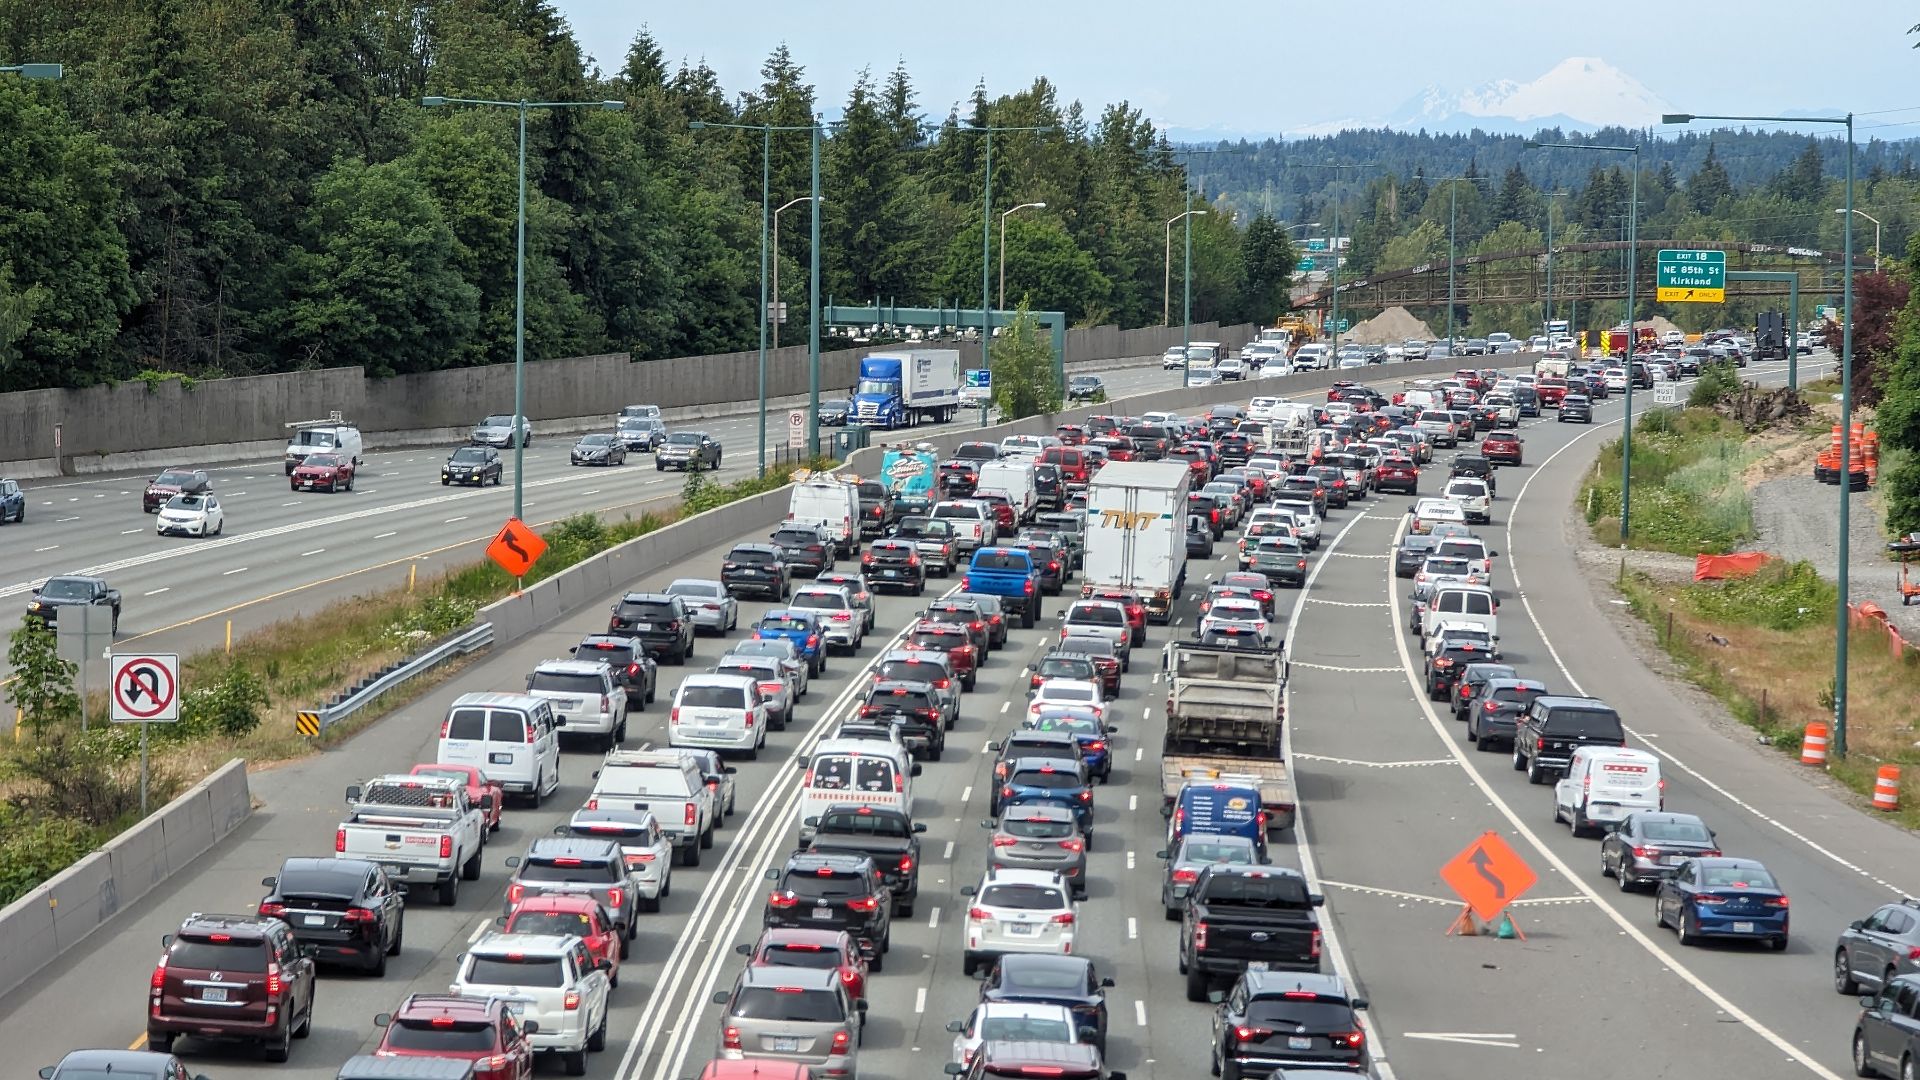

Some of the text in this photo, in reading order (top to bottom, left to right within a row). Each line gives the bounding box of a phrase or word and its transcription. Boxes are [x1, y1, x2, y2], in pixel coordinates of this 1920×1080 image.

[1695, 252, 1708, 261] 18
[1663, 266, 1720, 275] NE 85th St
[1670, 276, 1712, 286] Kirkland
[1100, 509, 1160, 531] TWT
